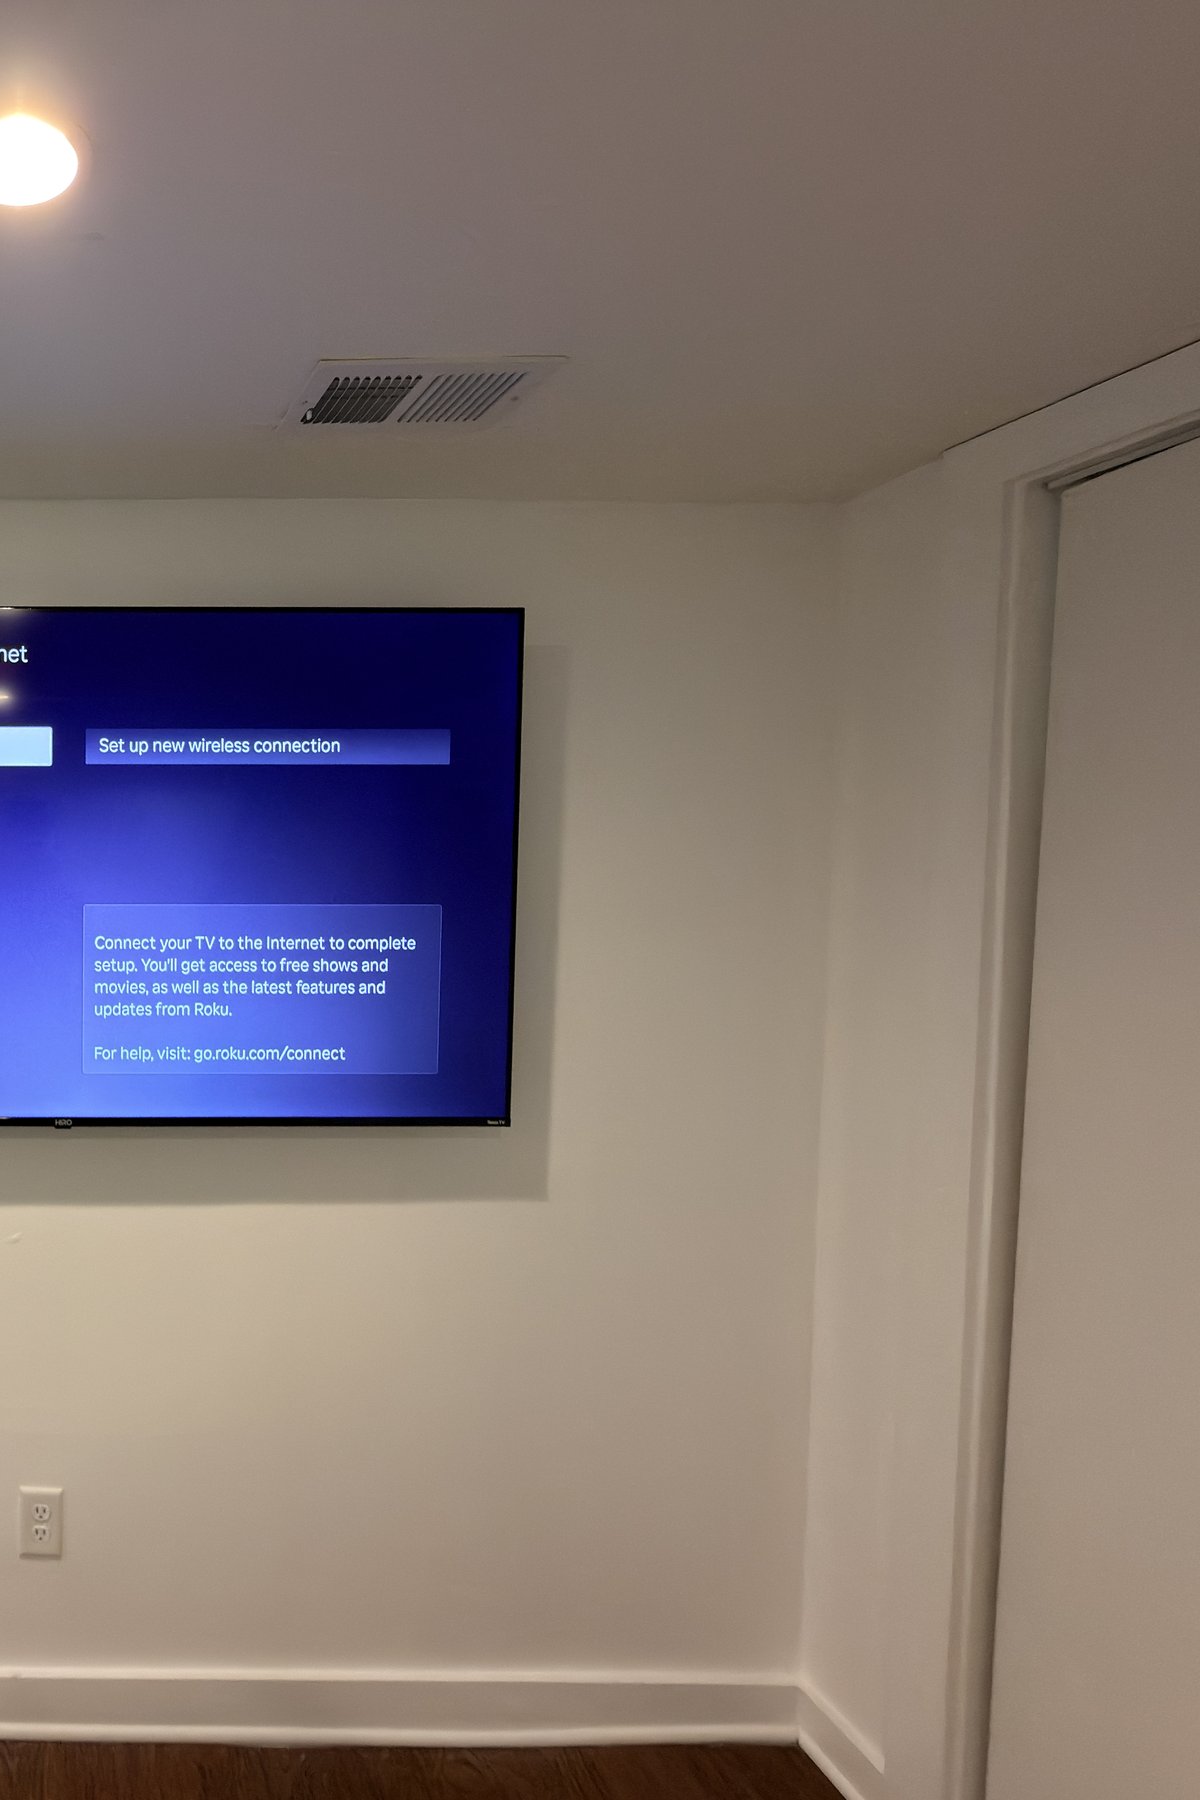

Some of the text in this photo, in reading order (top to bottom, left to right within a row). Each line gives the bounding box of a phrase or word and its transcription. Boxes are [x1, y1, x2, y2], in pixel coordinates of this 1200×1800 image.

[98, 737, 341, 757] Set up new wireless connection
[94, 935, 417, 953] Connect your TV to the Internet to complete
[94, 957, 389, 975] setup. You'll get access to free shows and
[94, 979, 386, 996] movies, as well as the latest features and
[94, 1001, 233, 1019] updates from Roku.
[94, 1045, 346, 1064] For help, visit: go.roku.com/connect
